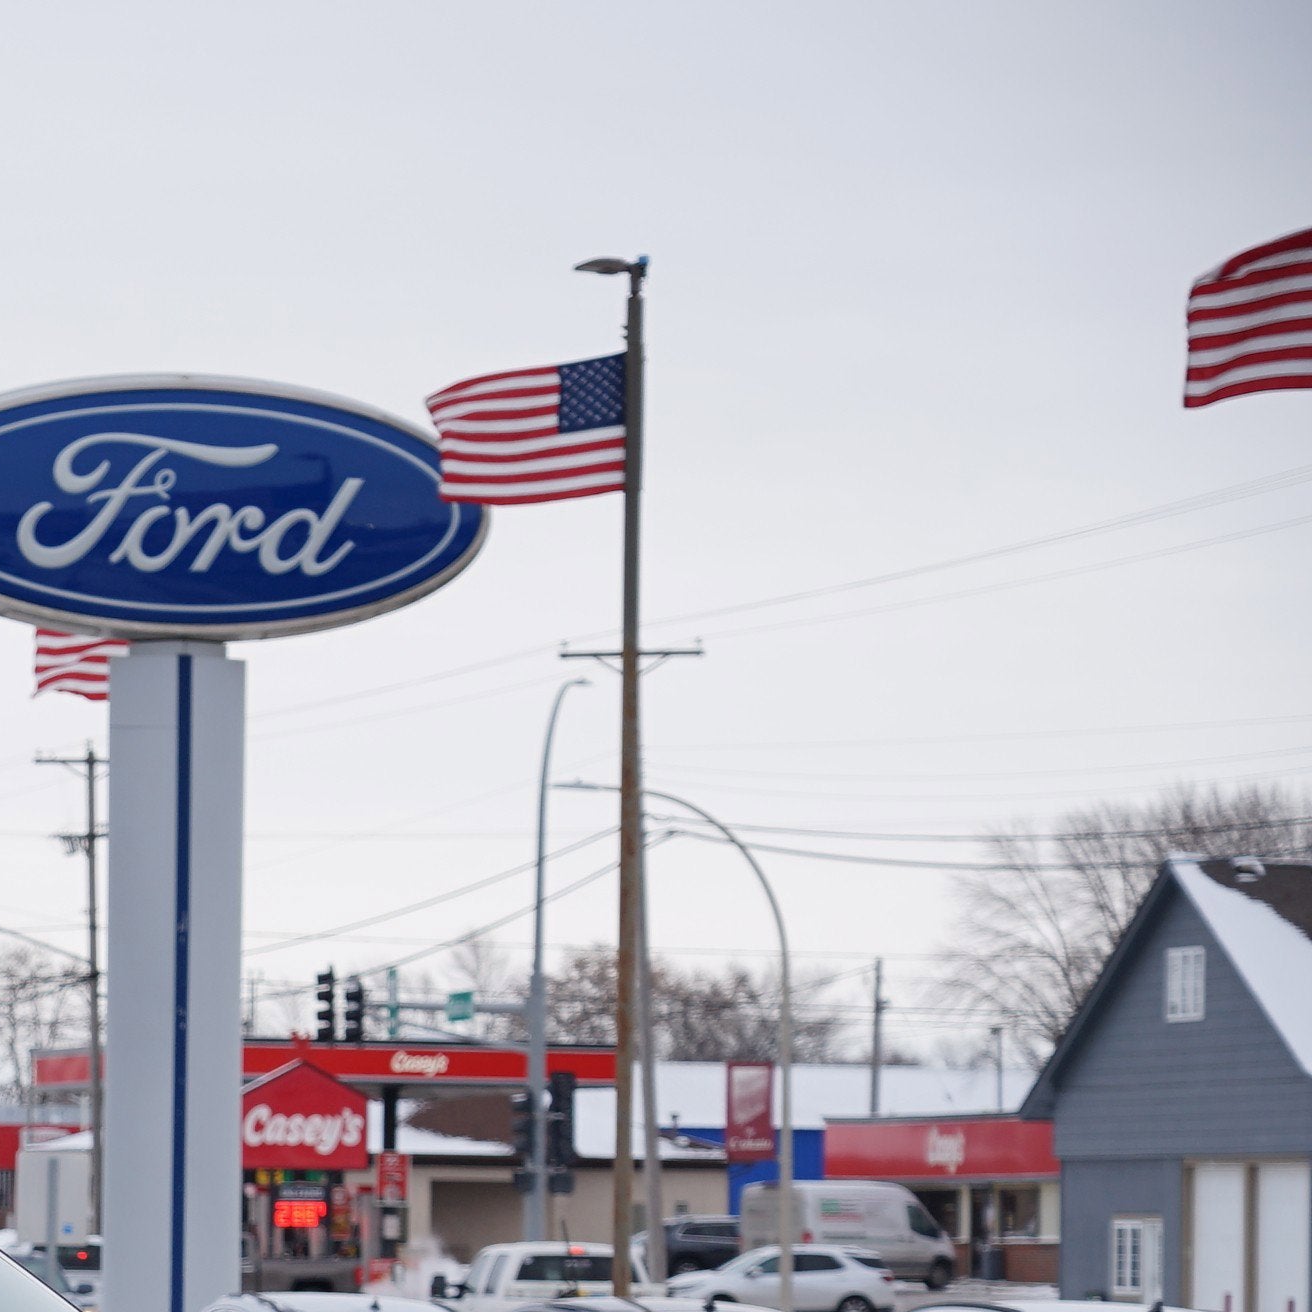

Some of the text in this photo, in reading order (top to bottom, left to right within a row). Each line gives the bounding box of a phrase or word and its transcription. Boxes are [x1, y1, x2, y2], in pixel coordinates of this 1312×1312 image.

[16, 432, 366, 576] Ford
[390, 1050, 449, 1077] Casey's
[244, 1104, 365, 1155] Casey's
